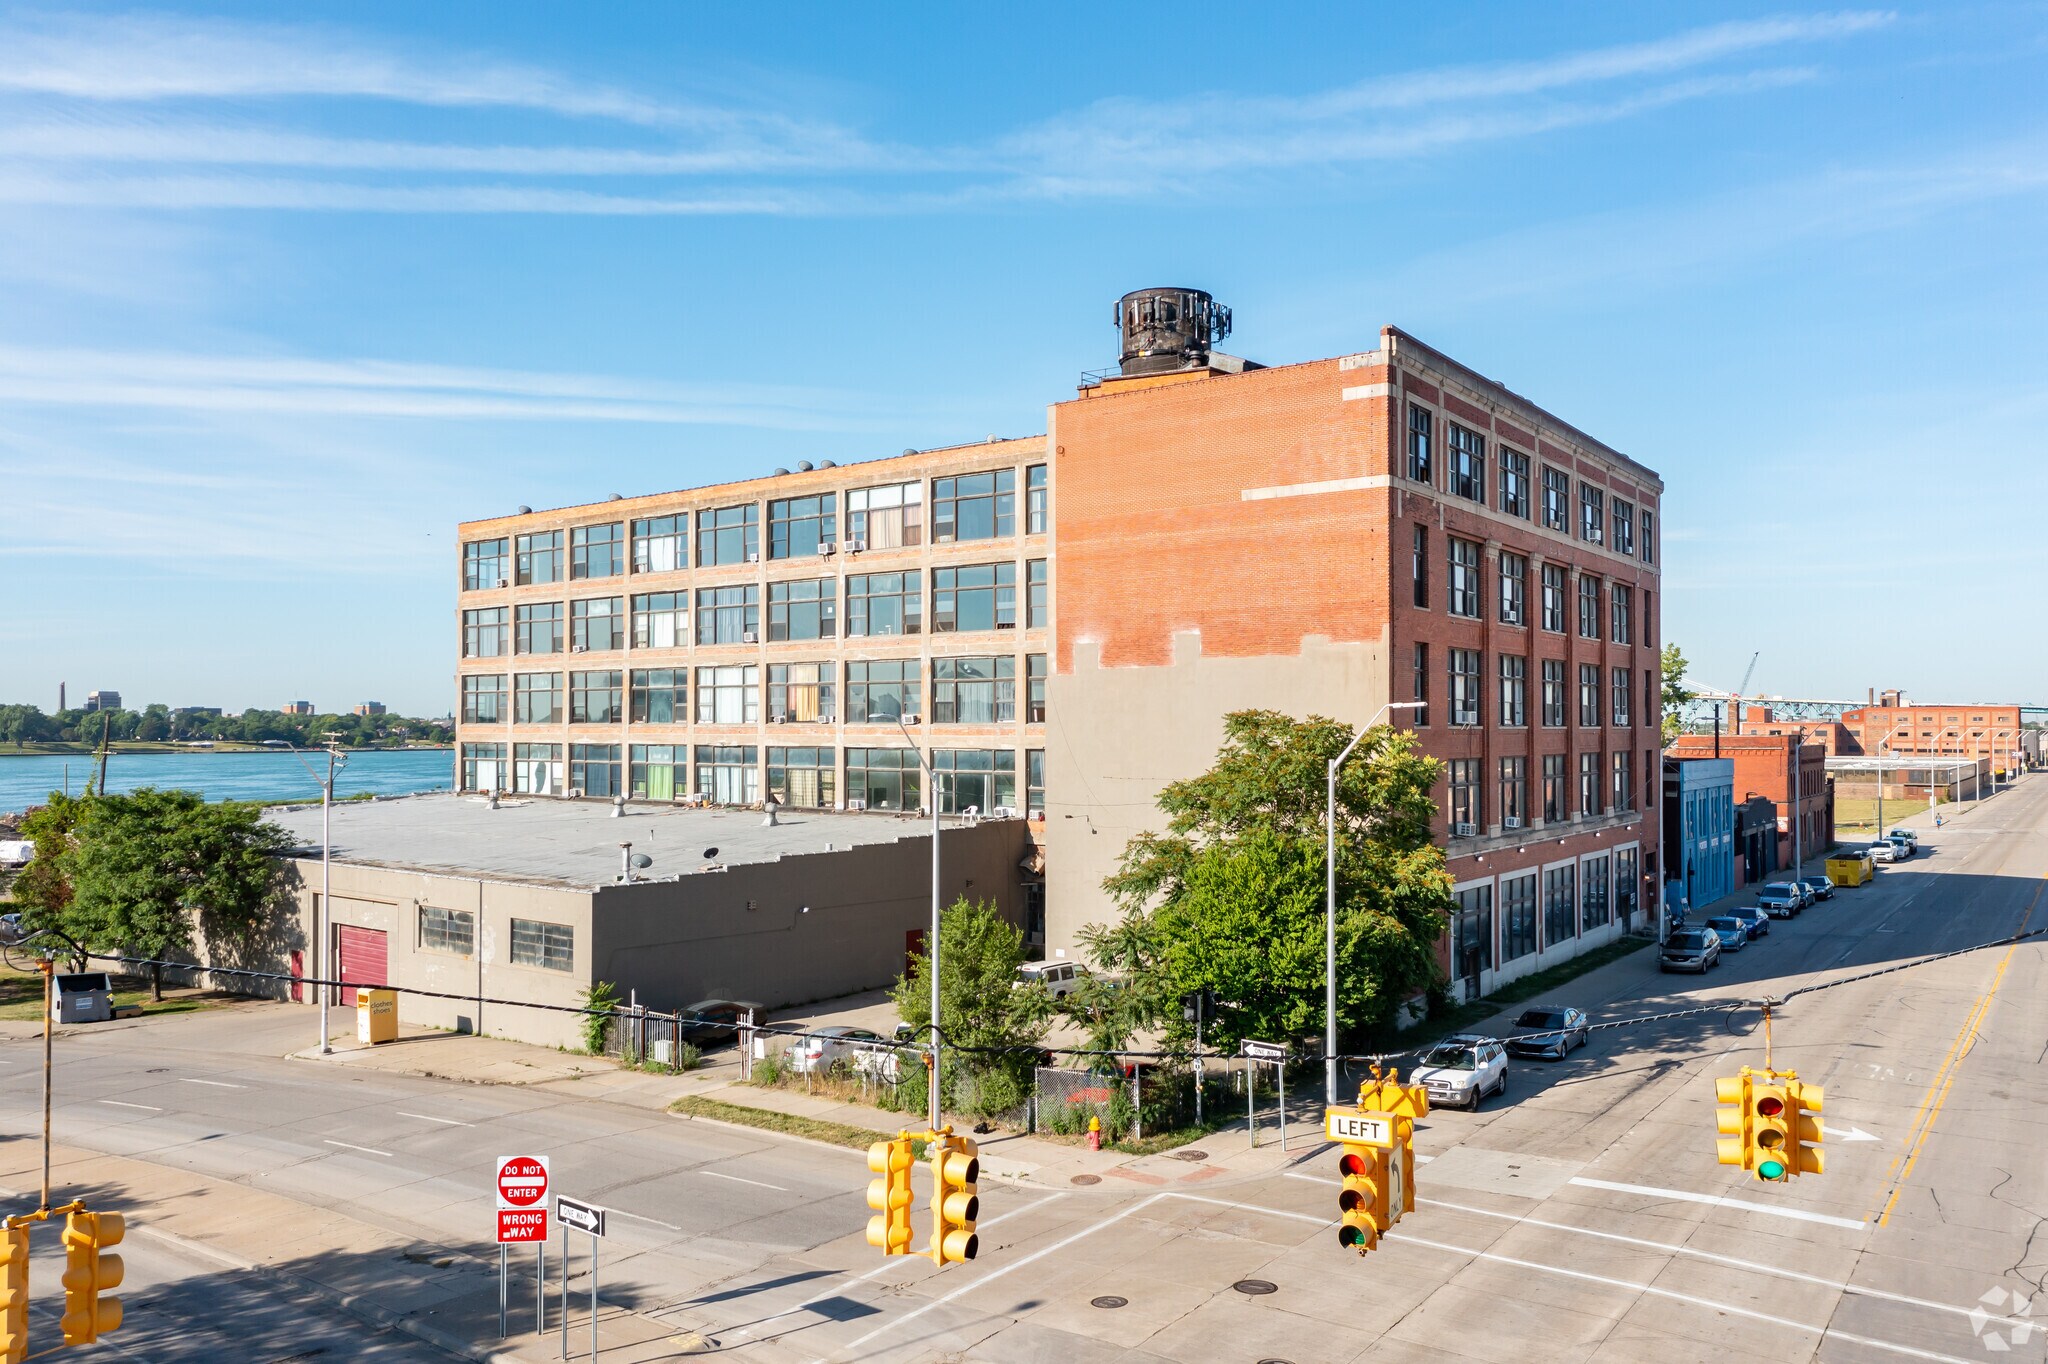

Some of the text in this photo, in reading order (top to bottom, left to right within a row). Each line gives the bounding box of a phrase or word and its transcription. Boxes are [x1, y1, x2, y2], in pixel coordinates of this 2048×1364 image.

[370, 1000, 393, 1008] clothes
[1254, 1047, 1265, 1055] ONE
[1338, 1118, 1380, 1139] LEFT
[505, 1166, 542, 1175] DO NOT
[507, 1188, 537, 1198] ENTER
[503, 1214, 542, 1225] WRONG
[563, 1207, 588, 1222] ONE WAY
[510, 1226, 535, 1238] WAY
